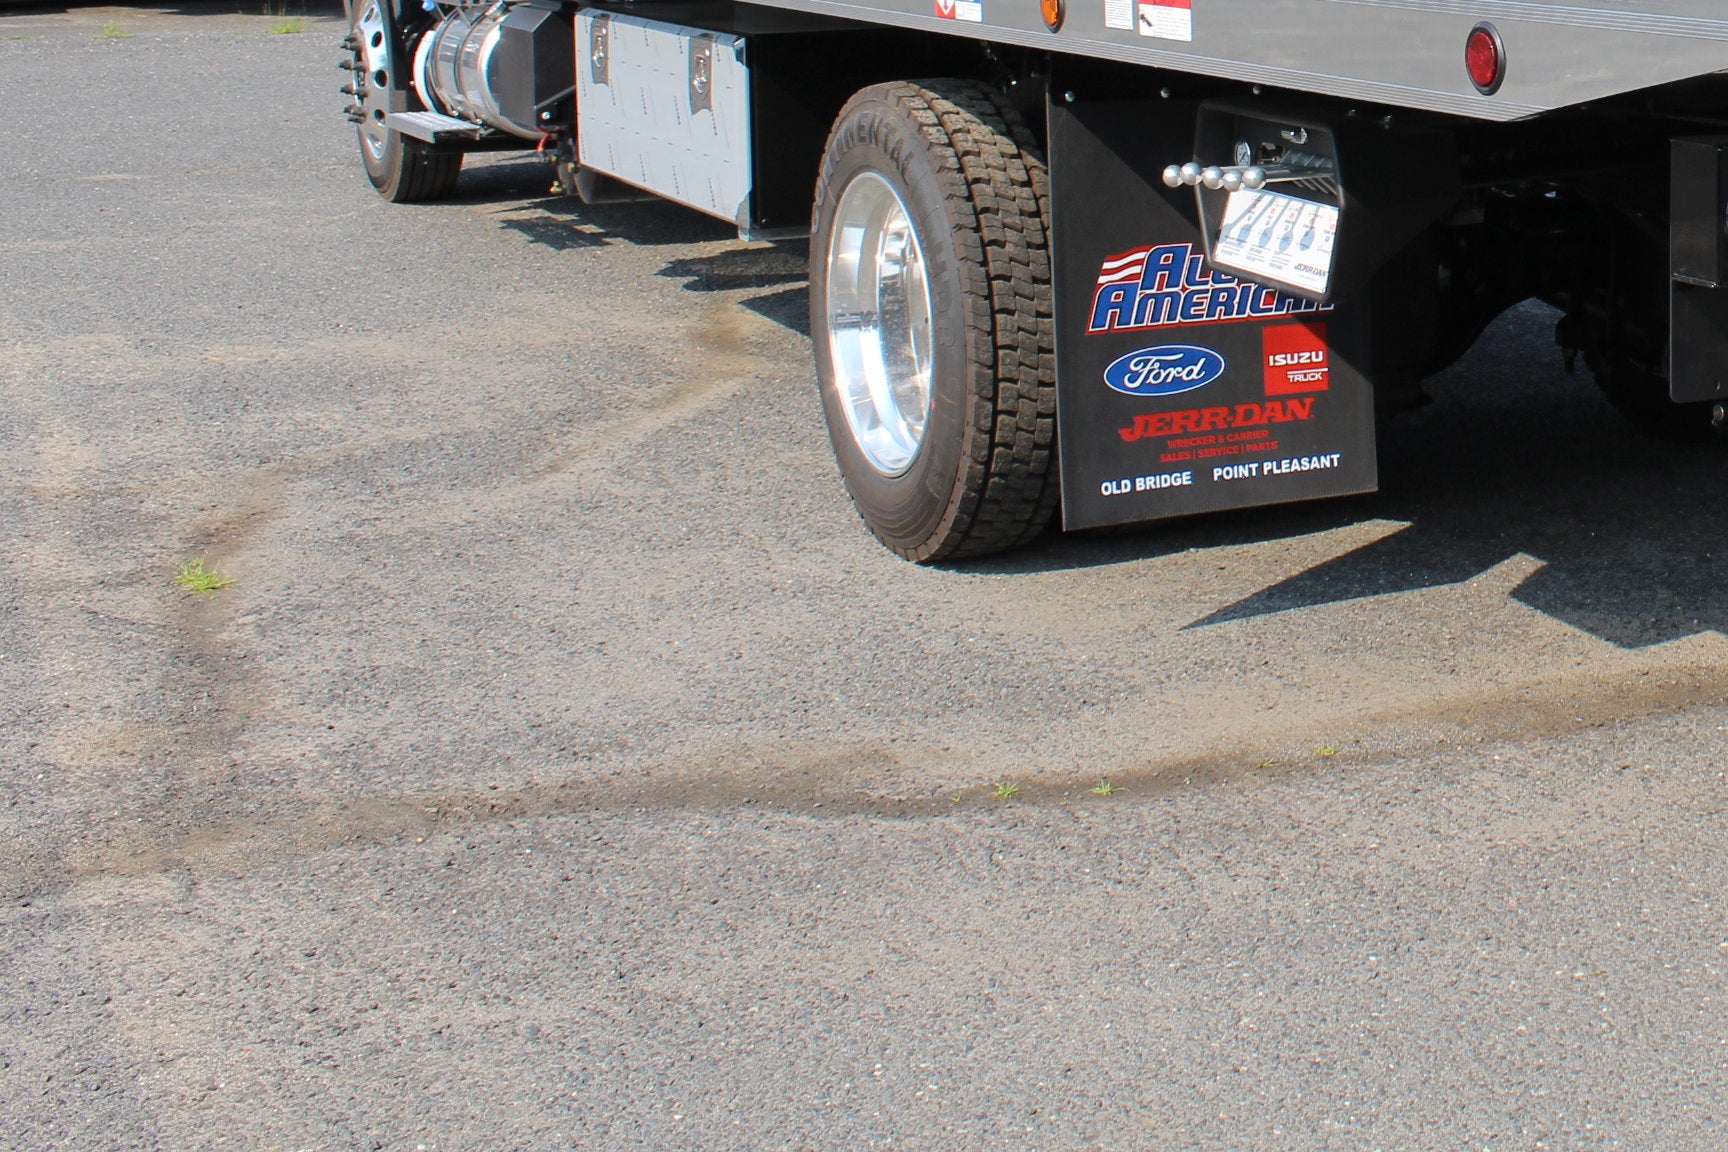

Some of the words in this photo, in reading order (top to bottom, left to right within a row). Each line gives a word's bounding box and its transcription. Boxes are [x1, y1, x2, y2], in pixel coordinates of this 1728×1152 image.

[1268, 350, 1324, 367] ISUZU
[1123, 353, 1207, 389] Ford
[1287, 371, 1323, 384] TRUCK
[1167, 435, 1216, 449] WRECKER
[1217, 434, 1226, 444] &
[1226, 429, 1270, 441] CARRIER
[1159, 450, 1192, 463] SALES
[1197, 444, 1241, 458] SERVICE
[1246, 440, 1279, 453] PARTS
[1100, 479, 1132, 497] OLD
[1135, 470, 1192, 492] BRIDGE
[1213, 462, 1260, 482] POINT
[1262, 453, 1341, 476] PLEASANT
